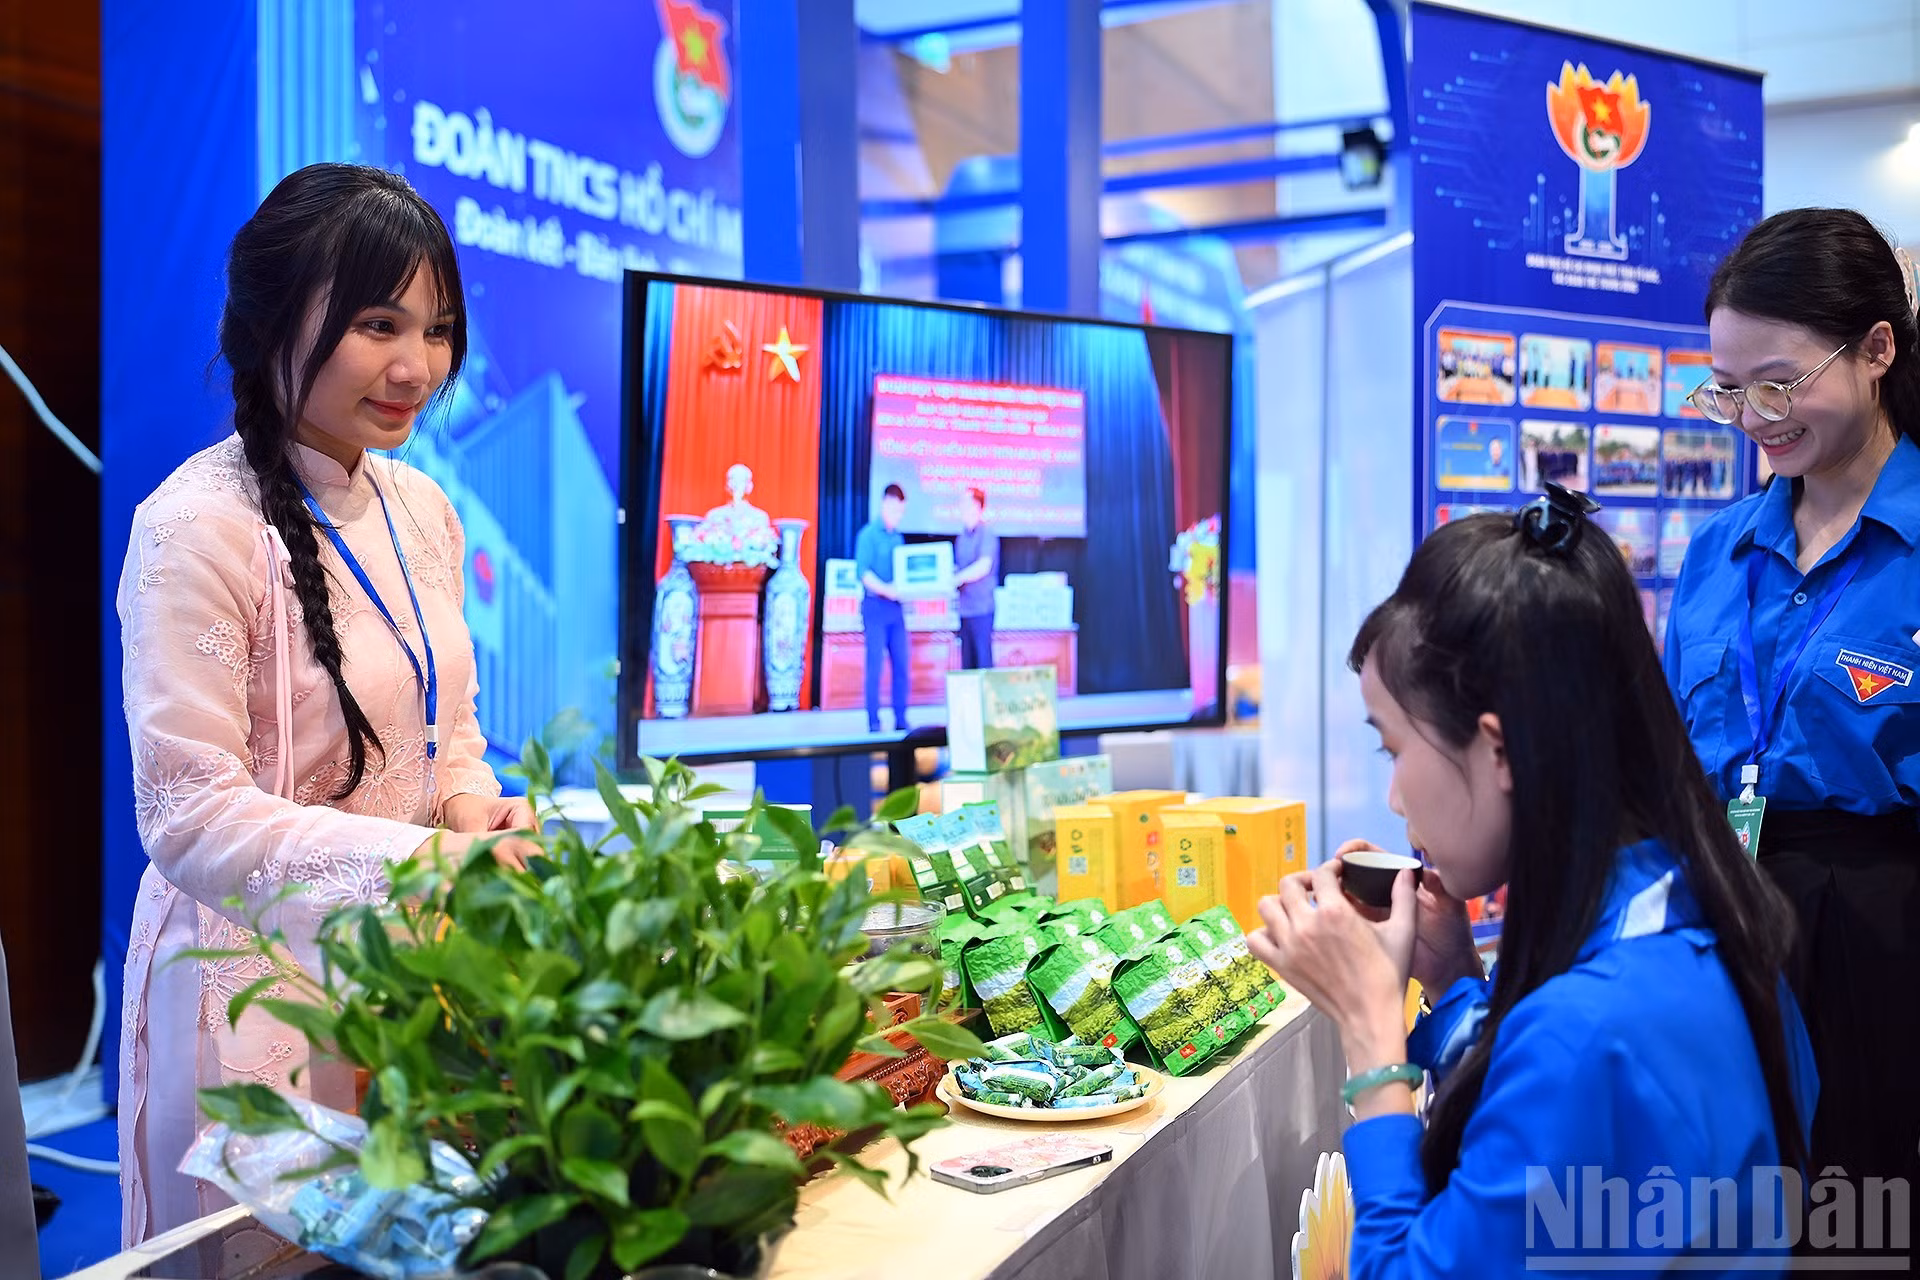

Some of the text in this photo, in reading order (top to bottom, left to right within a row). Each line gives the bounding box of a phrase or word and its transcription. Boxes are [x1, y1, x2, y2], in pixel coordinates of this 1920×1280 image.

[411, 100, 526, 193] ĐOÀN
[528, 138, 619, 221] TNCS
[1840, 654, 1907, 680] THANH NIÊN VIỆT NAM
